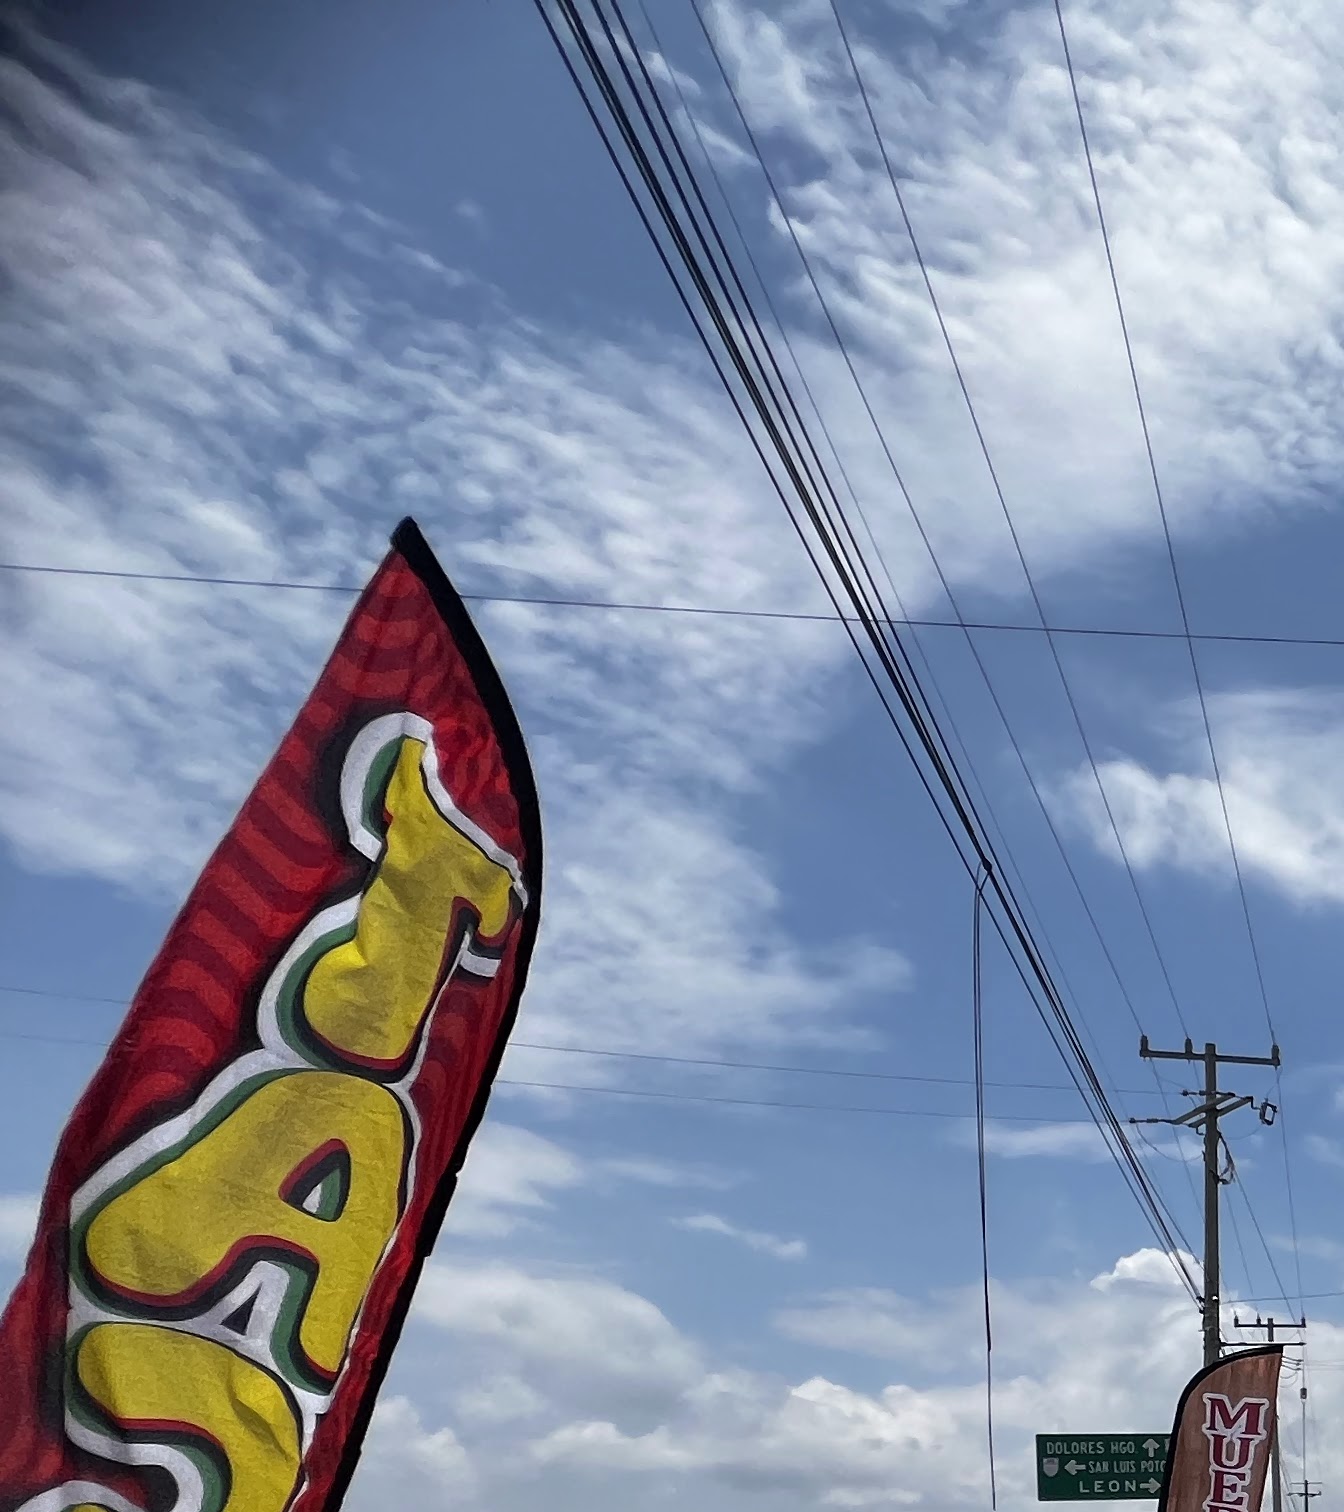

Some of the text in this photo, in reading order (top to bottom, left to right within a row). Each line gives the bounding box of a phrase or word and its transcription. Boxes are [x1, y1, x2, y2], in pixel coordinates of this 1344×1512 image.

[1046, 1441, 1105, 1455] DOLORES
[1088, 1460, 1109, 1474] SAN
[1114, 1460, 1136, 1474] LUIS
[1079, 1480, 1137, 1493] LEON
